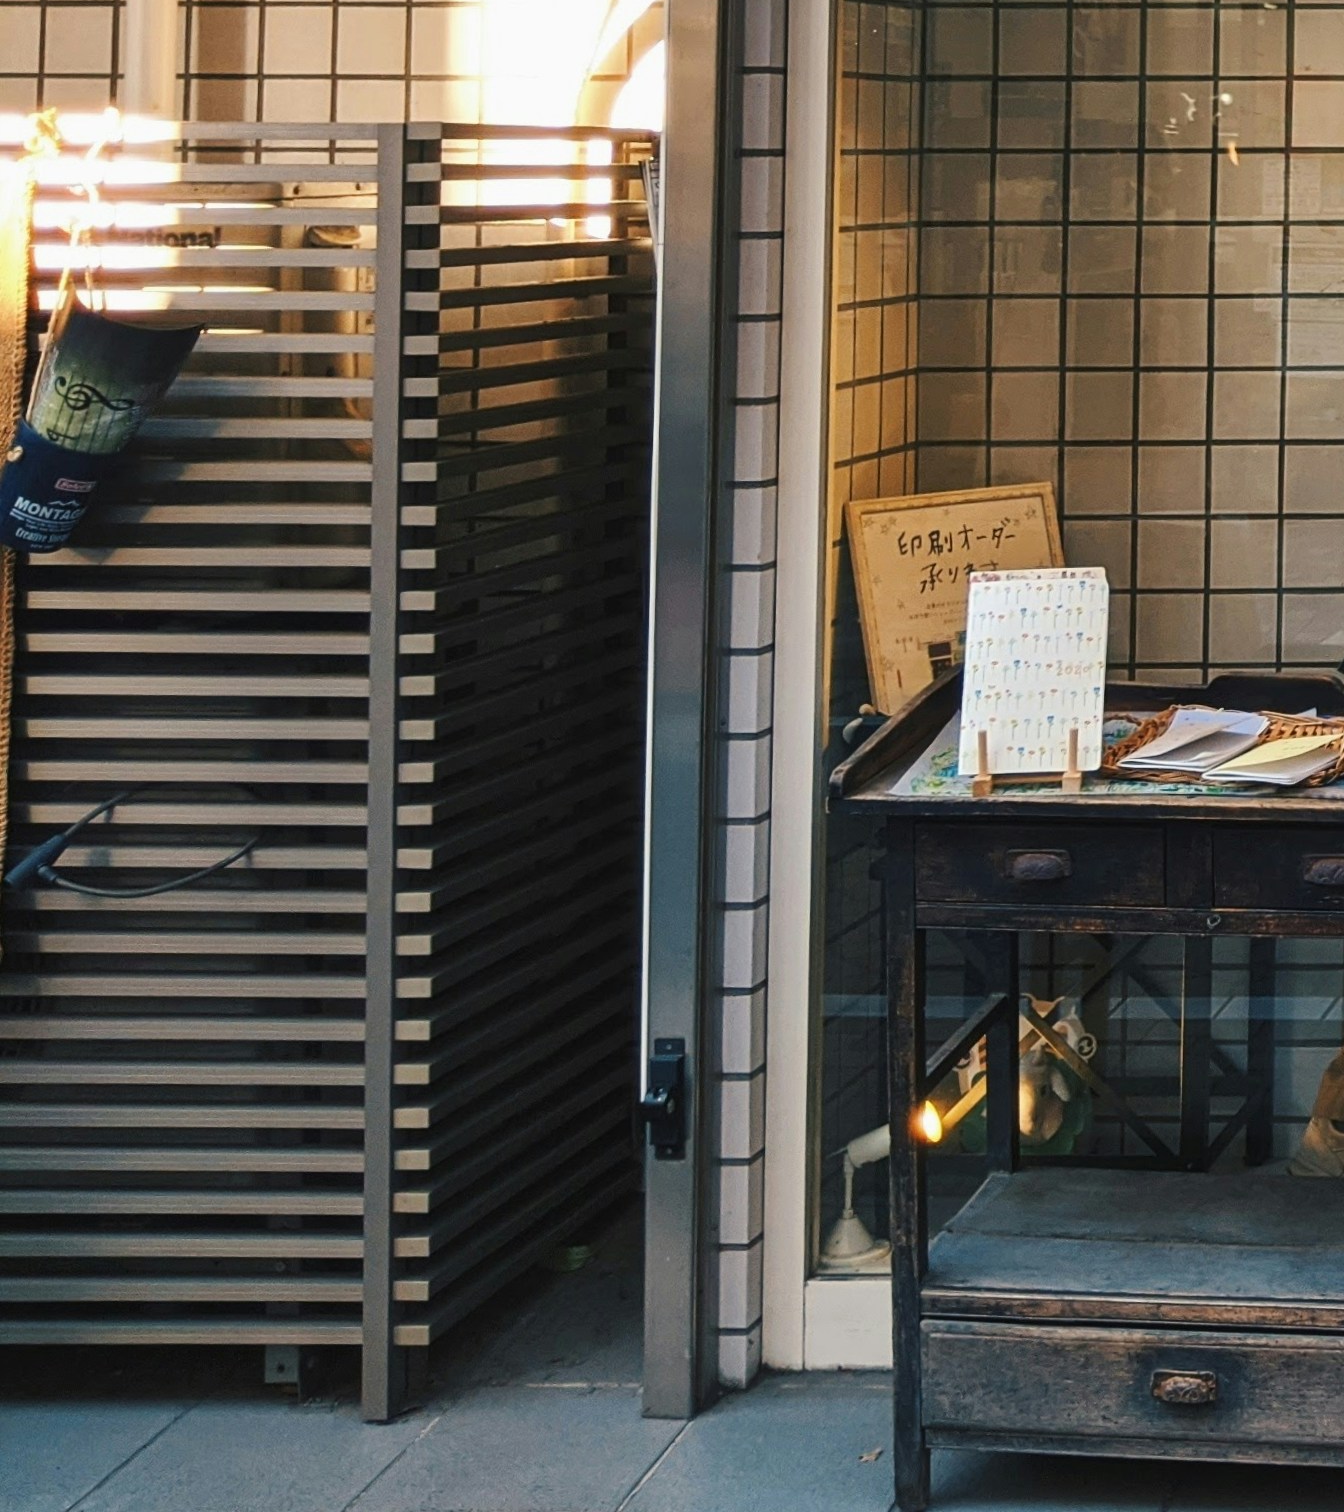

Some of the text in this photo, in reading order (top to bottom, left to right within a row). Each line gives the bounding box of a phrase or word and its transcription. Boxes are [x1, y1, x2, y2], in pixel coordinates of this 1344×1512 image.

[897, 516, 1017, 557] 印刷オーダー
